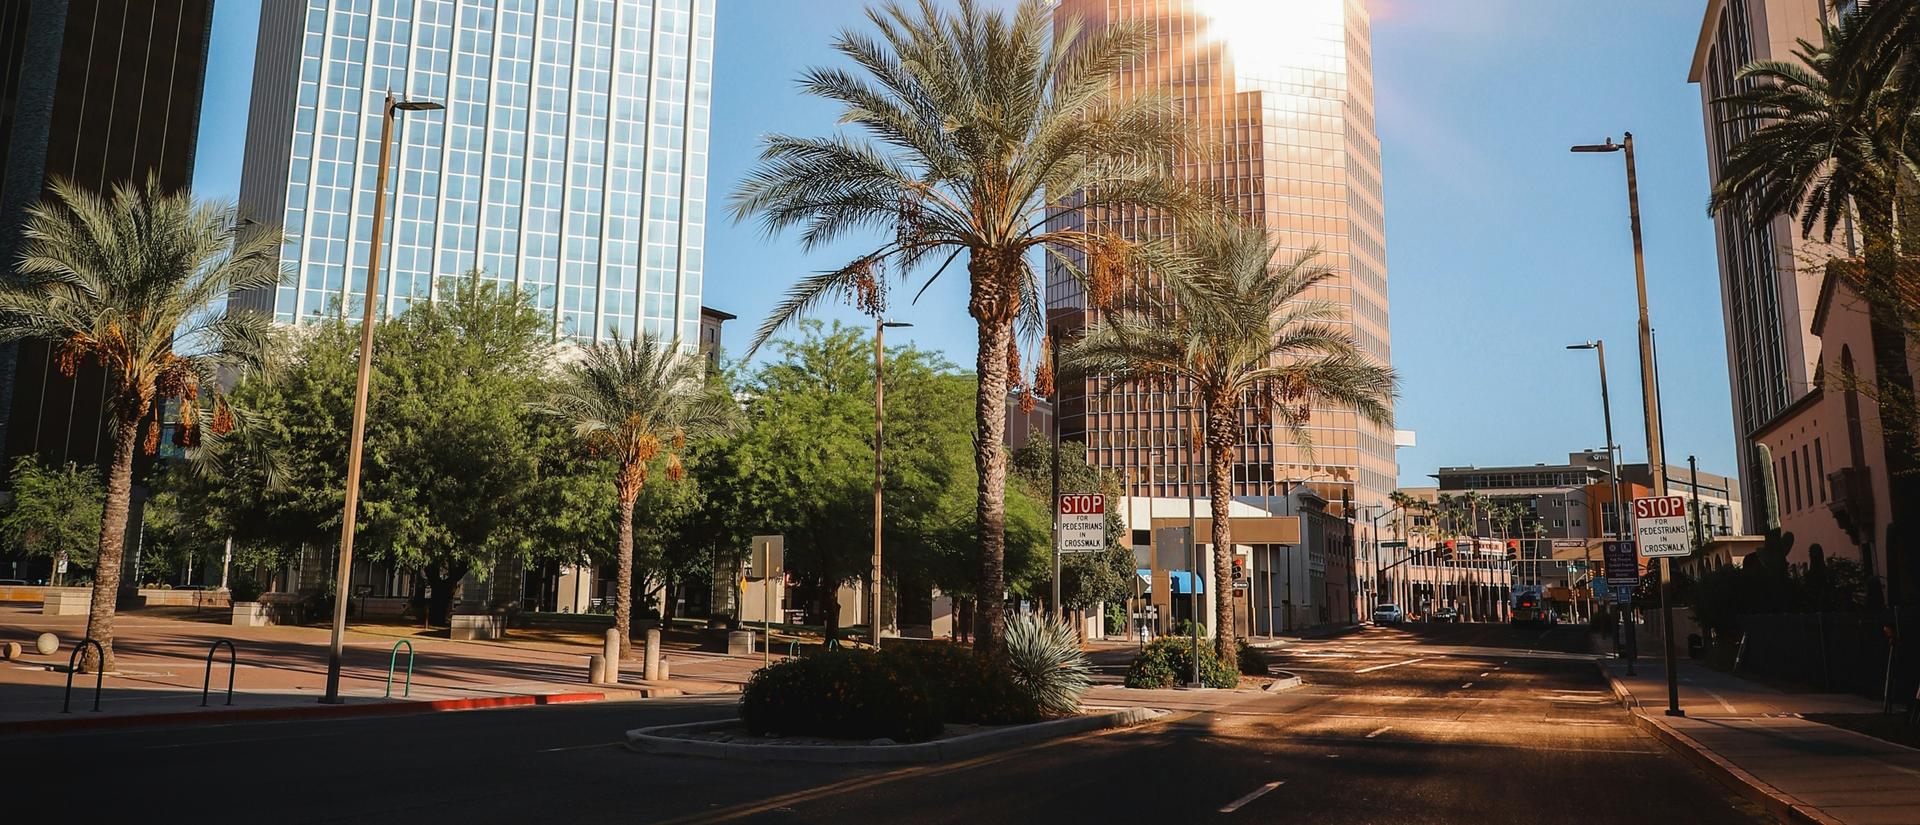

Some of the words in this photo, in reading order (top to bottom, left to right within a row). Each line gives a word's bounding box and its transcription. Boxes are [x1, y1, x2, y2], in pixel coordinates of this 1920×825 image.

[1062, 496, 1102, 513] STOP
[1637, 498, 1682, 517] STOP
[1640, 526, 1686, 536] PEDESTRIANS
[1644, 544, 1684, 552] CROSSWALK
